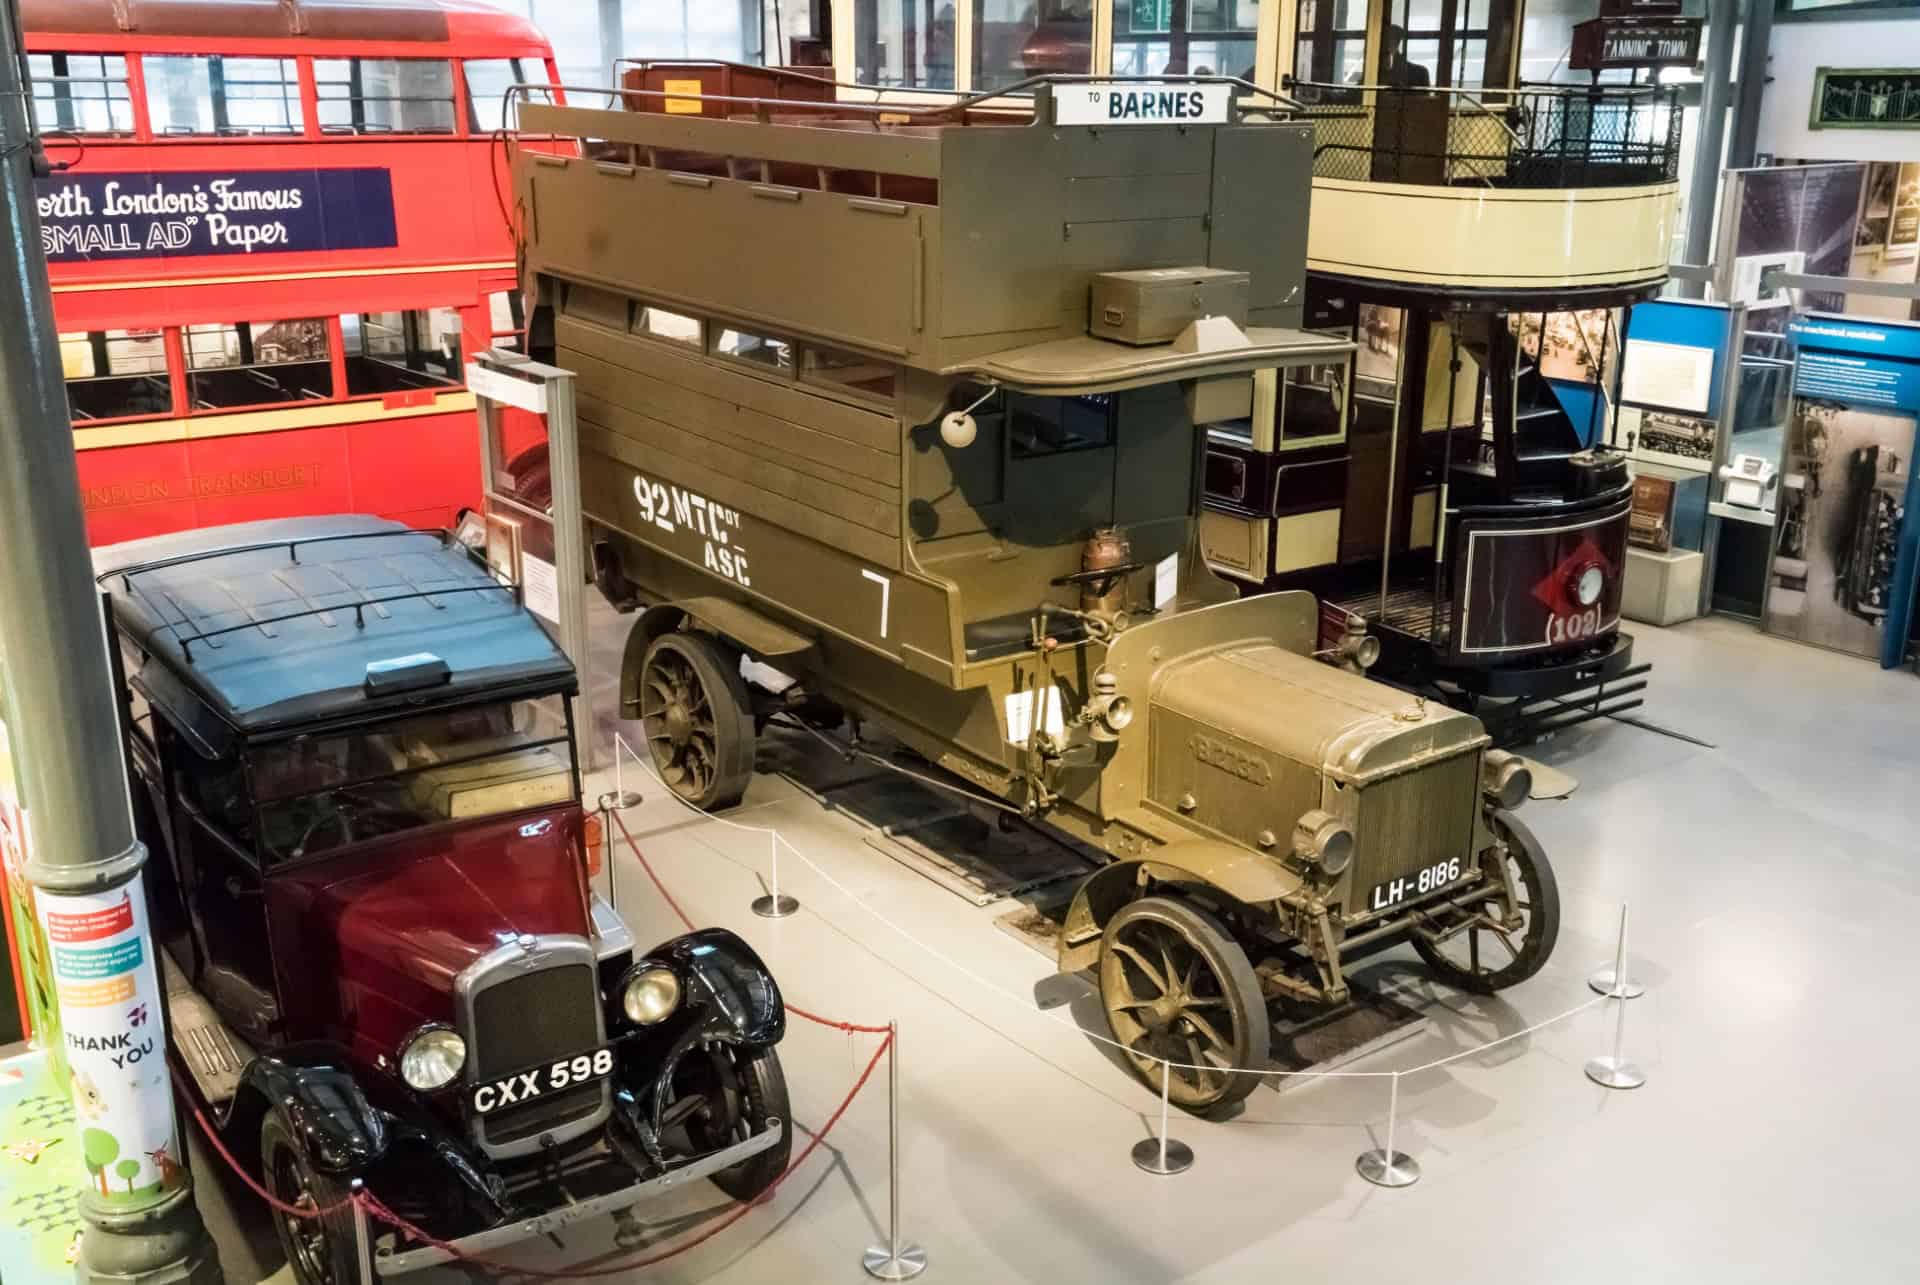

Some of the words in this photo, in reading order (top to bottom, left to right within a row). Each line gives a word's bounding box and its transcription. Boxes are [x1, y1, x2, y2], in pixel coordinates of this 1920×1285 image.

[1088, 92, 1100, 103] TO
[1108, 91, 1204, 118] BARNES
[37, 184, 93, 217] orth
[102, 182, 209, 216] London's
[211, 179, 302, 212] Famous
[206, 214, 289, 252] Paper
[66, 1031, 131, 1051] THANK
[111, 1037, 154, 1069] YOU
[474, 1070, 541, 1113] CXX
[550, 1049, 613, 1089] 598
